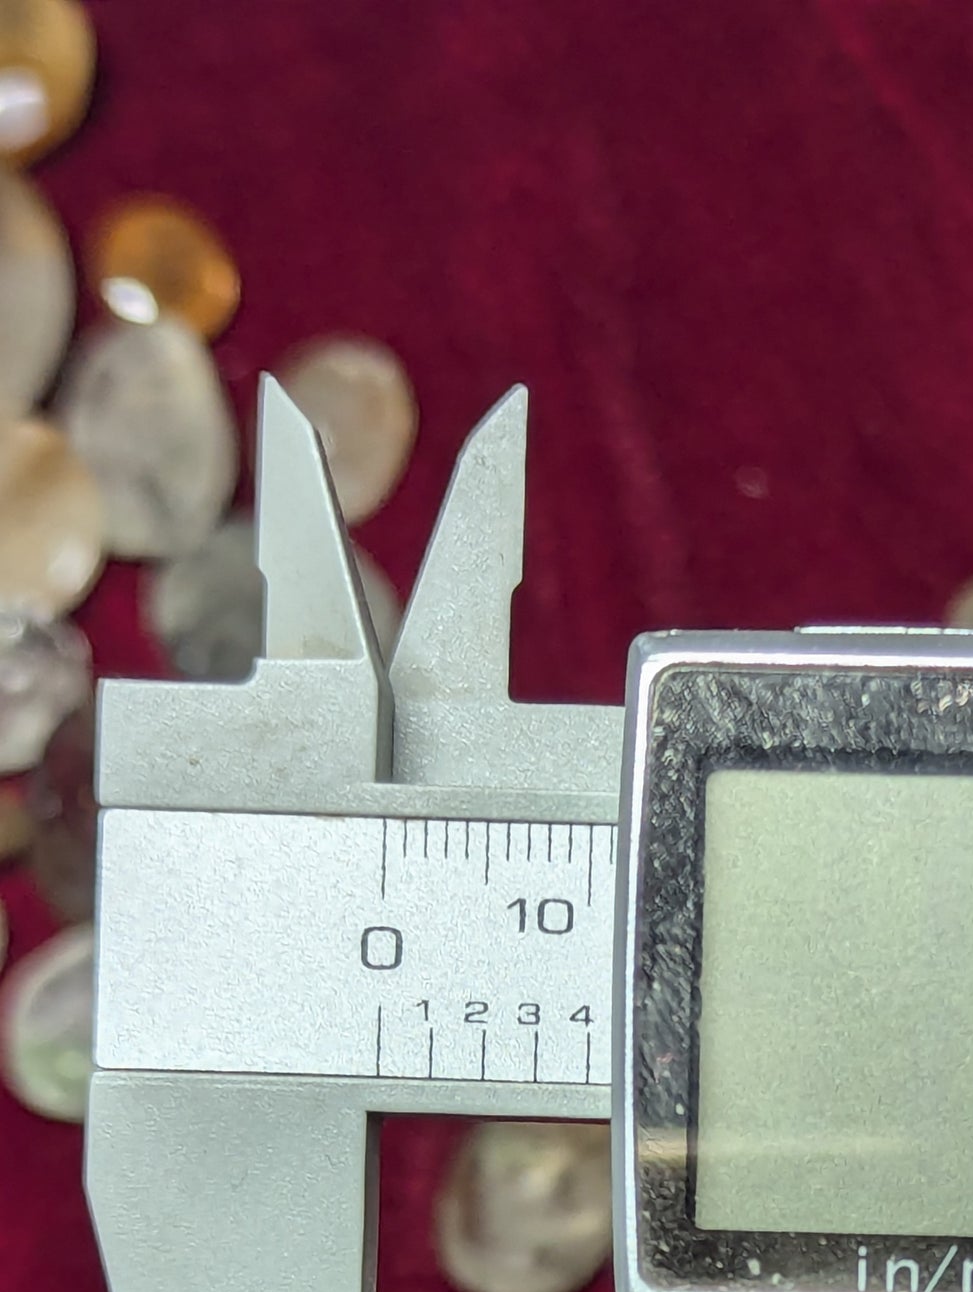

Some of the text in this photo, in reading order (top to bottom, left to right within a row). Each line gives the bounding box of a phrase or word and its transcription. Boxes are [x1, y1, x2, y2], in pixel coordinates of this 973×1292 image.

[507, 897, 574, 935] 10
[360, 925, 403, 970] 0
[416, 999, 594, 1027] 1 2 3 4
